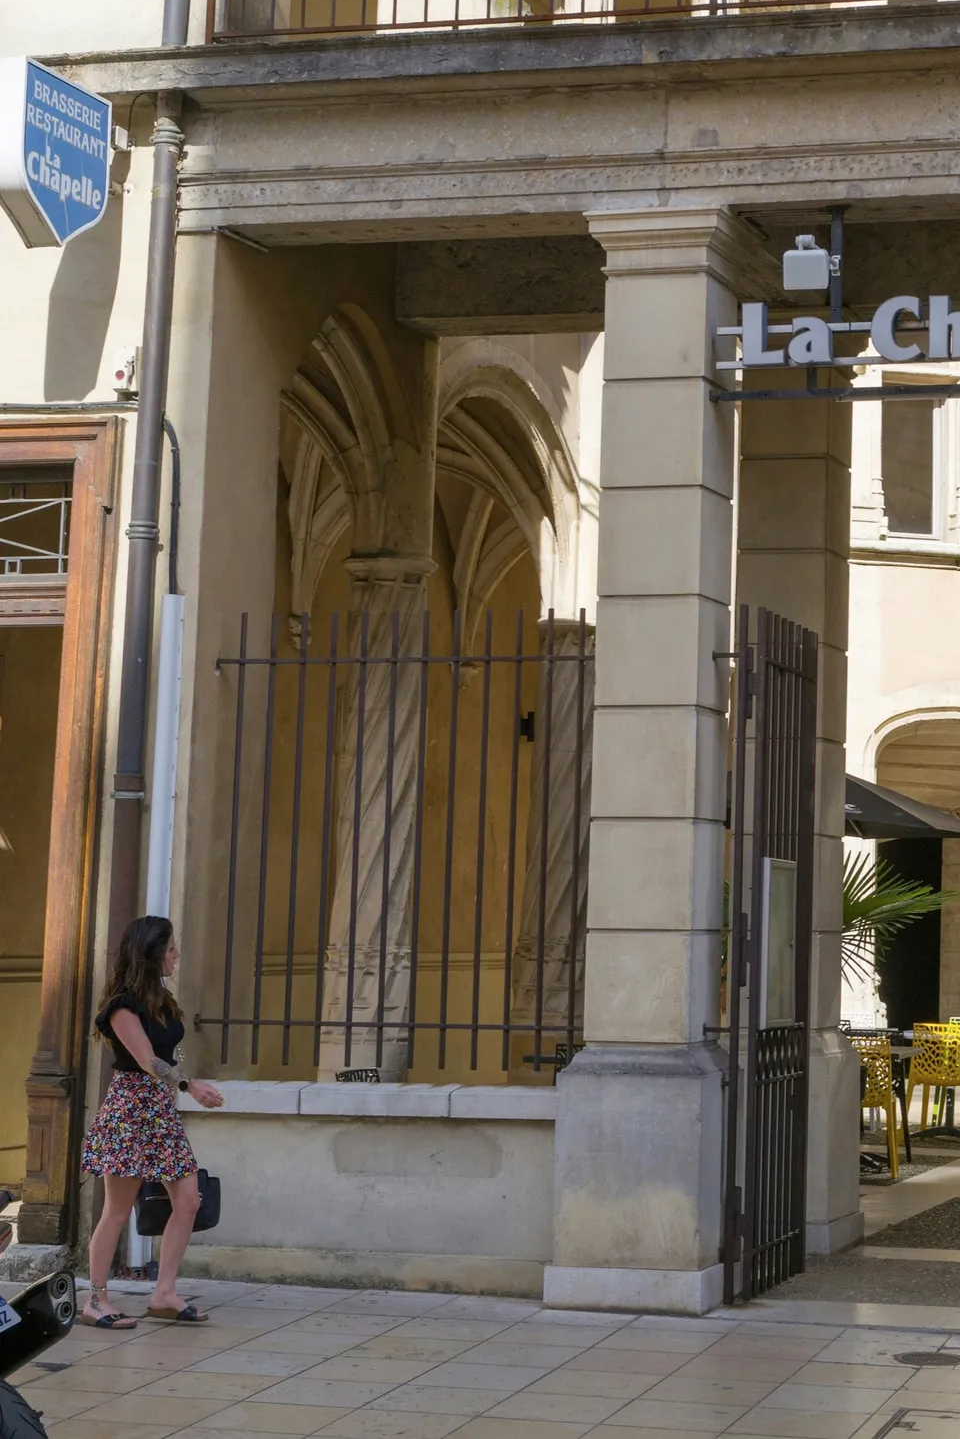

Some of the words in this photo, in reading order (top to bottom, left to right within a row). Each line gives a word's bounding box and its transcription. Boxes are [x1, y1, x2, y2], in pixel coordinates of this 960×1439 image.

[27, 103, 105, 161] RESTAURANT
[34, 80, 101, 132] BRASSERIE
[27, 150, 102, 210] Chapelle
[45, 146, 61, 170] La
[741, 301, 833, 367] La
